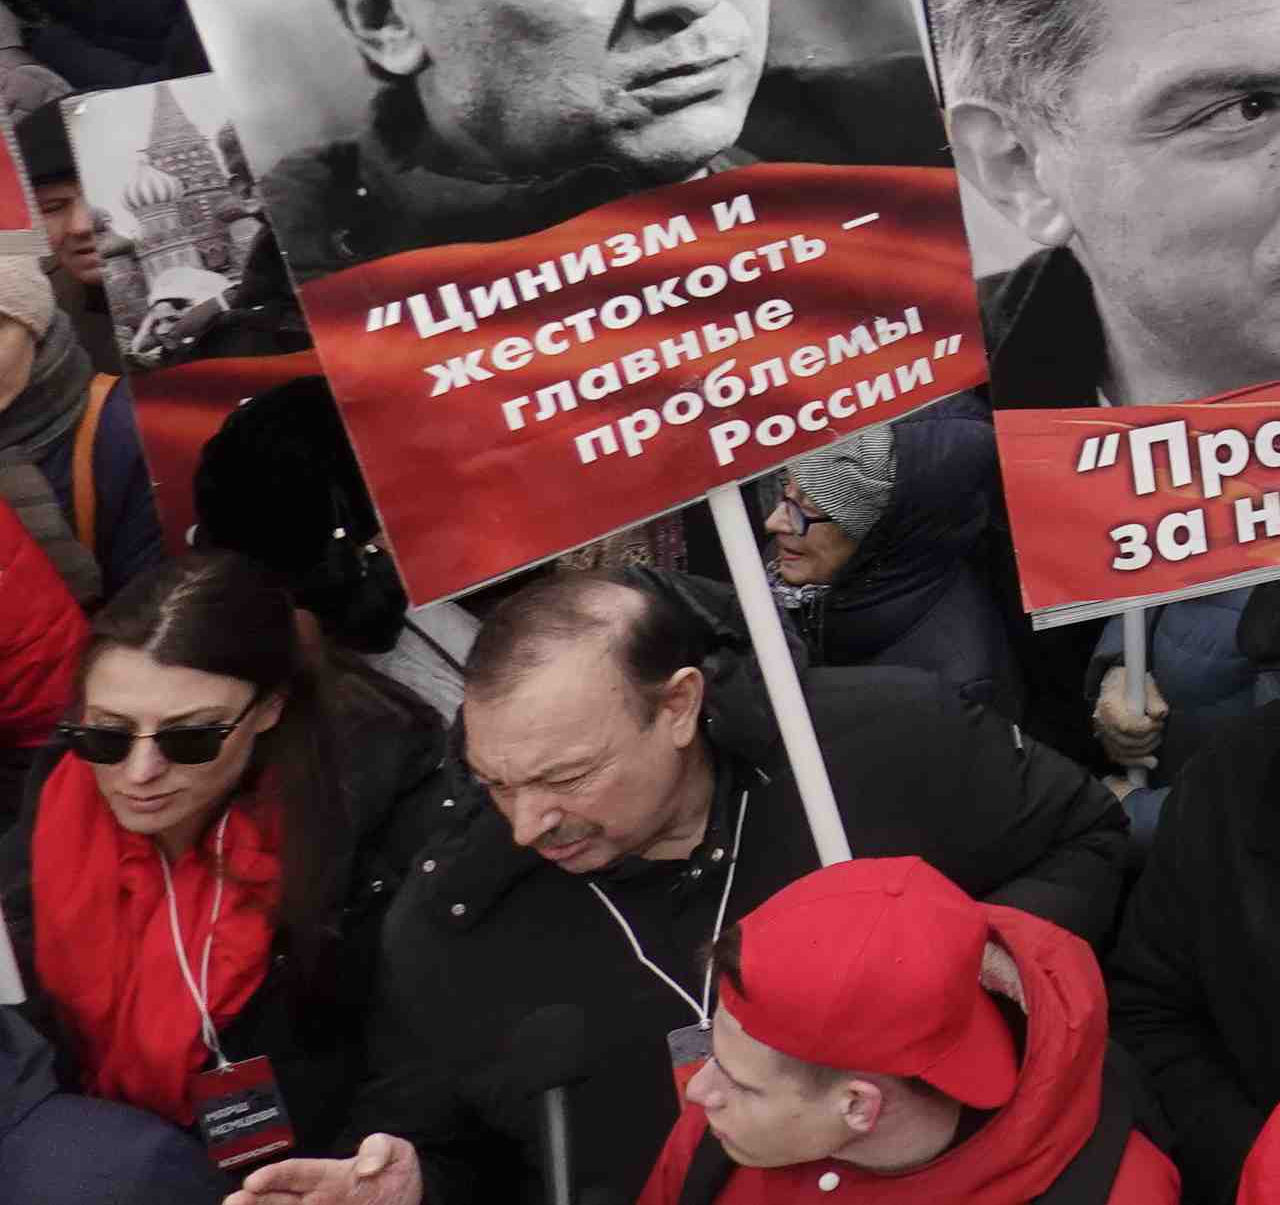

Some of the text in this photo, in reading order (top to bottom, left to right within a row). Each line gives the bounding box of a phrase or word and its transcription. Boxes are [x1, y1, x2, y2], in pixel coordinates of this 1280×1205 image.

[366, 192, 757, 340] “Цинизм и
[423, 232, 829, 399] жестокость
[500, 296, 796, 433] главные
[573, 304, 925, 466] проблемы
[709, 333, 964, 468] России”
[1109, 507, 1209, 573] за
